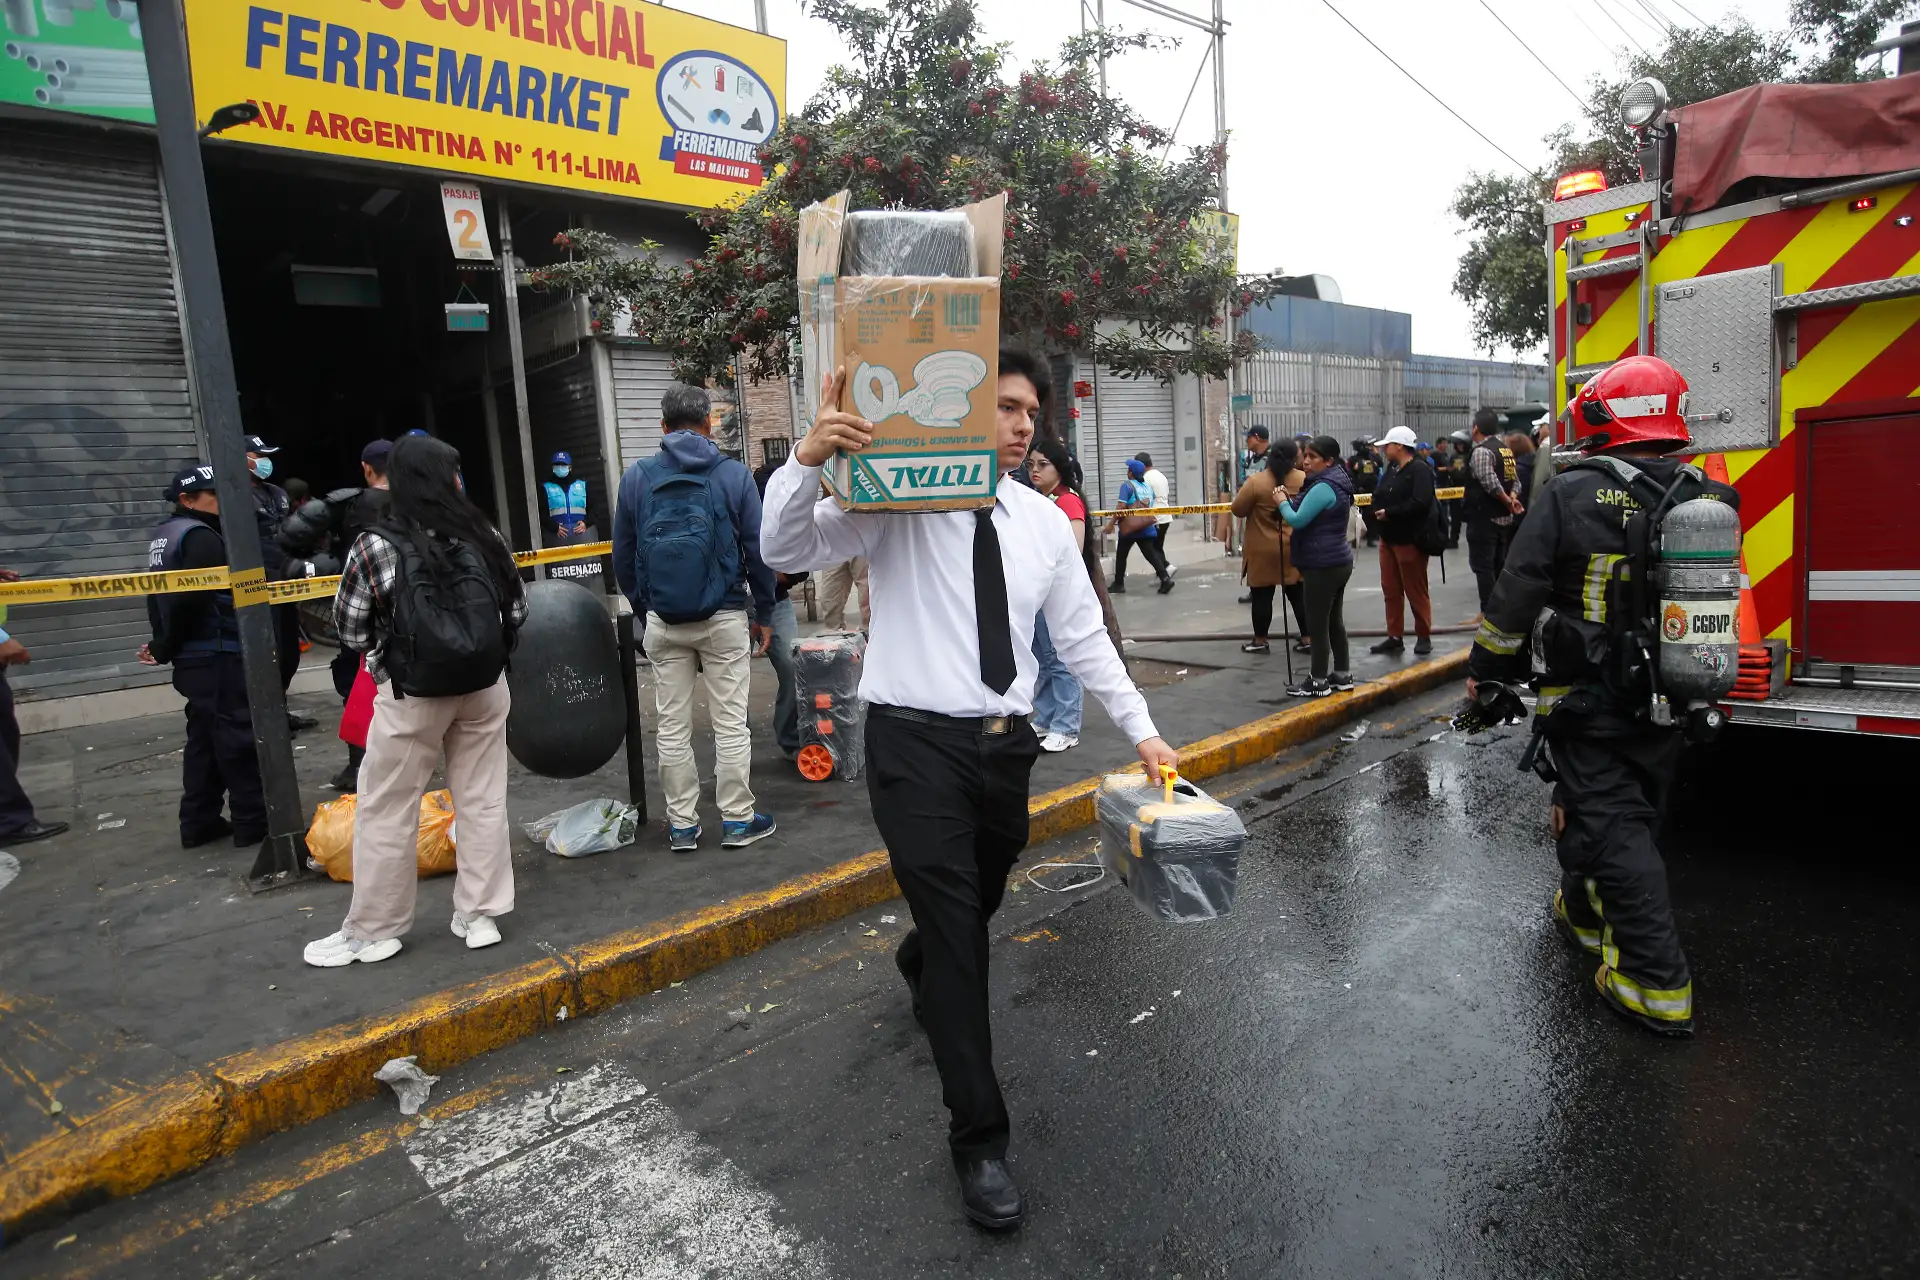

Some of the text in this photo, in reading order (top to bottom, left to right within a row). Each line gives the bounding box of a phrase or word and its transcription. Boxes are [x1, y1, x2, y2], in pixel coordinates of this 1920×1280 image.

[245, 5, 630, 137] FERREMARKET
[305, 108, 487, 163] ARGENTINA
[531, 147, 641, 185] 111-LIMA
[673, 130, 762, 165] FERREMARKE
[690, 159, 750, 179] LAS MALVINAS
[443, 188, 479, 200] PASAJE
[453, 209, 483, 249] 2
[1712, 362, 1720, 372] 5
[872, 435, 987, 448] AIR SANDER 150mm(6
[852, 467, 881, 500] TOTAL
[888, 463, 983, 490] TOTAL
[1595, 488, 1643, 509] SAPEU
[551, 563, 603, 578] SERENAZGO
[235, 577, 267, 589] GERENCI
[1692, 614, 1730, 634] CGBVP
